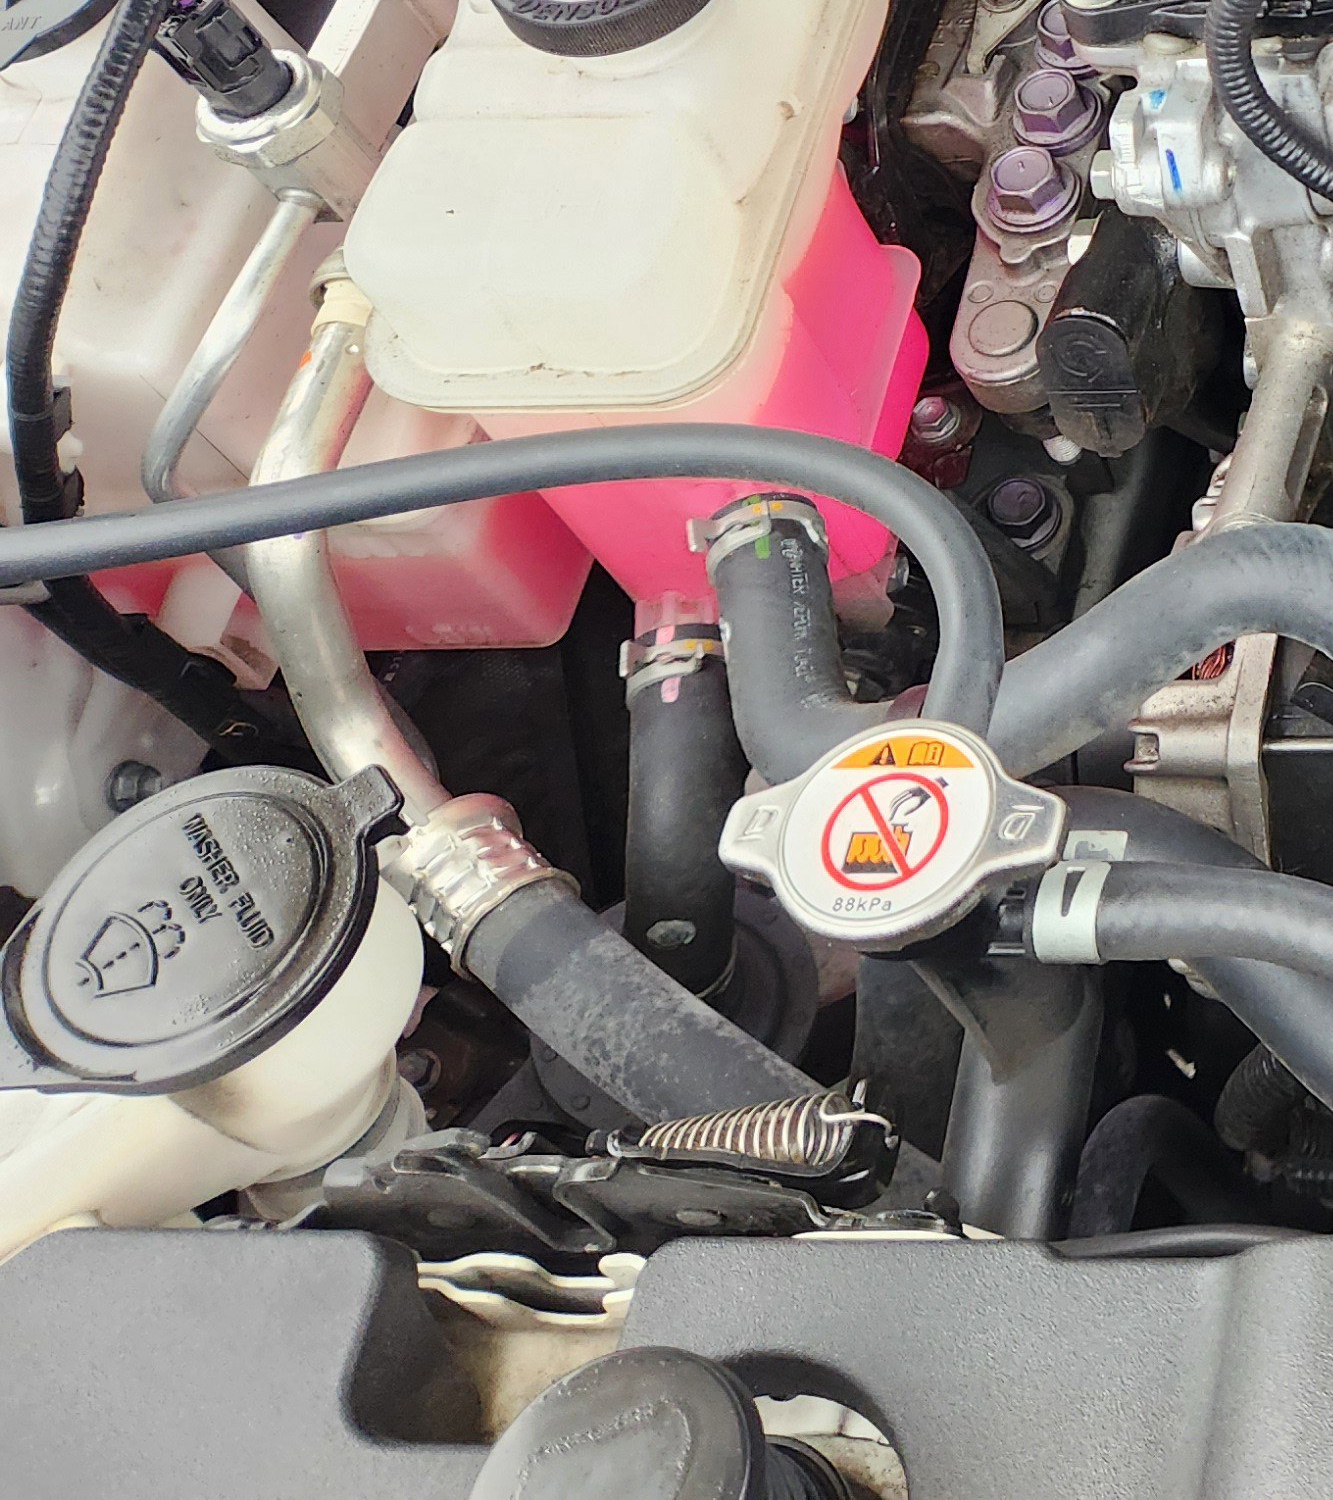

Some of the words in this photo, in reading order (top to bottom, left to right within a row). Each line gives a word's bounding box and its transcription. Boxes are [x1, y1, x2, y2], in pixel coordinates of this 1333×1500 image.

[178, 875, 223, 925] ONLY
[181, 812, 241, 895] WASHER
[227, 891, 276, 949] FLUID
[832, 896, 893, 914] 88kPa
